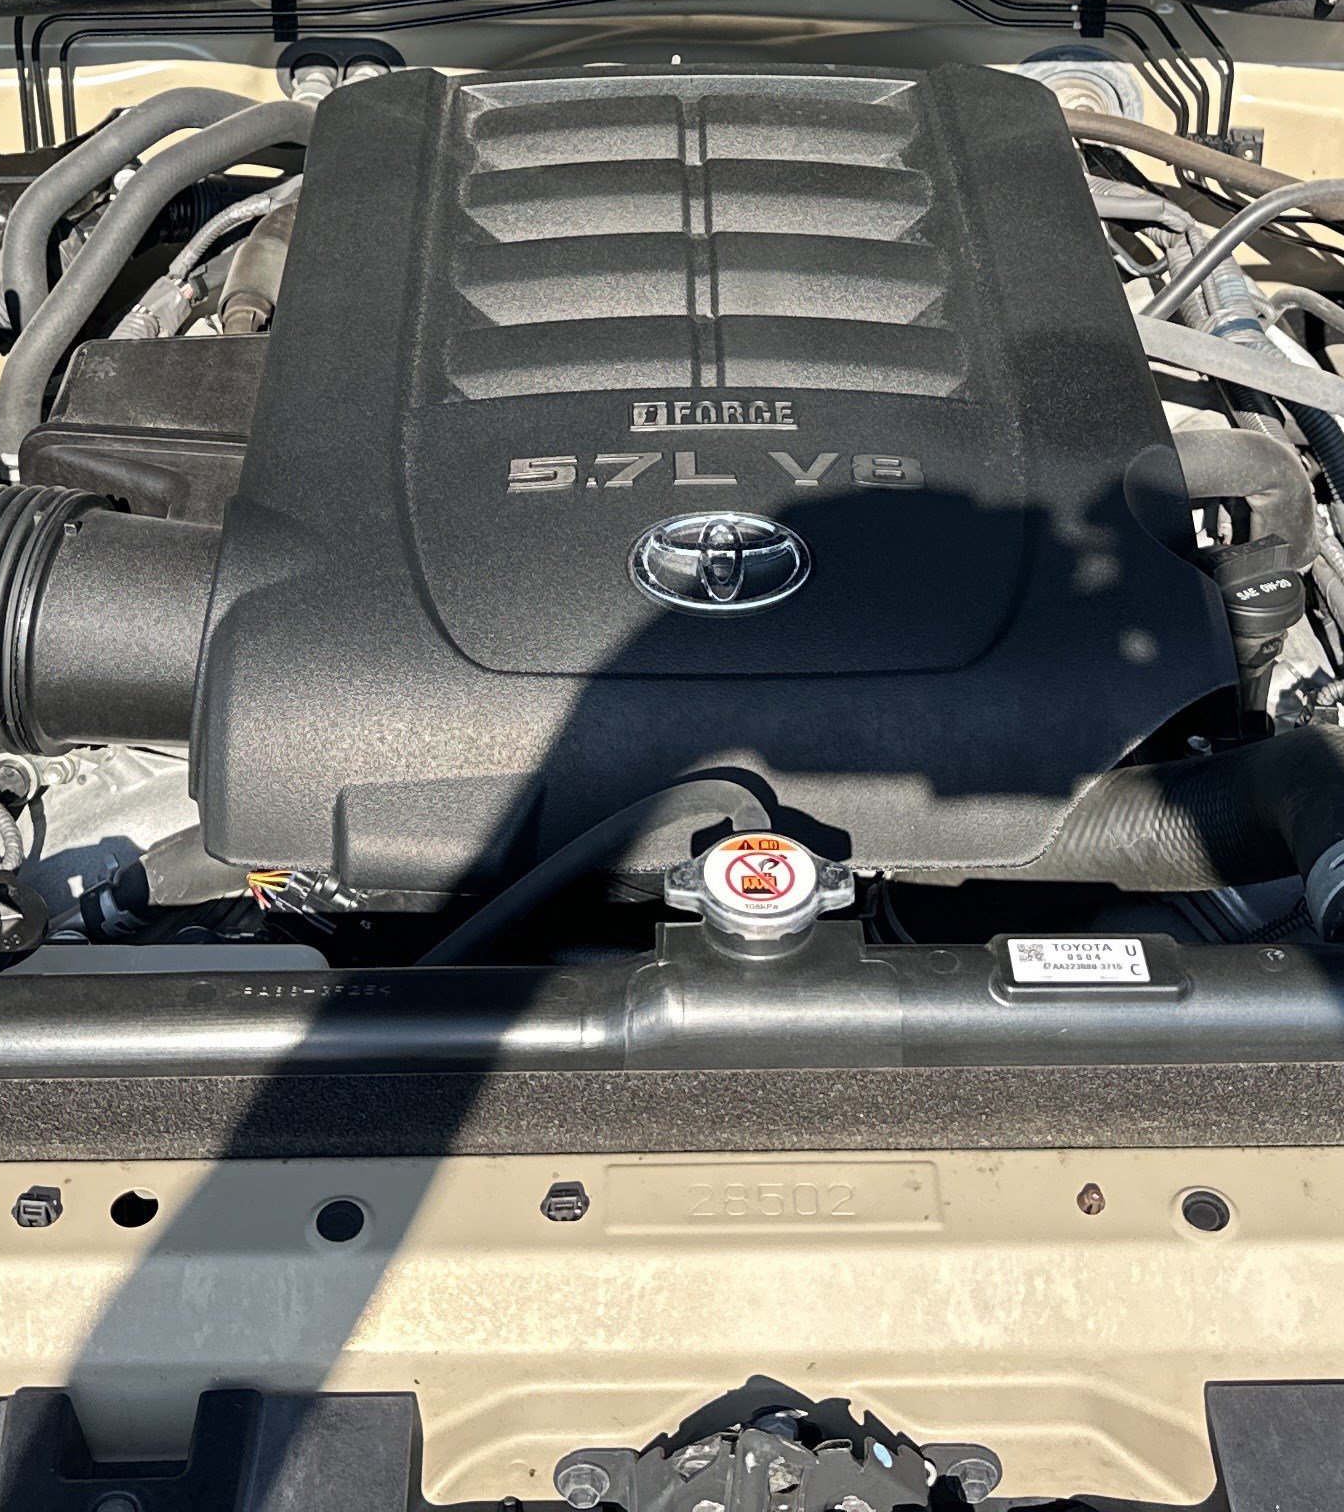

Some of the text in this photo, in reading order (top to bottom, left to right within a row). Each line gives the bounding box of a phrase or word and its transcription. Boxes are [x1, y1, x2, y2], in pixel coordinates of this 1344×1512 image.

[507, 450, 926, 494] 5.7L V8
[1235, 587, 1260, 601] SAE
[1051, 943, 1113, 952] TOYOTA
[1124, 944, 1137, 957] U
[1130, 963, 1143, 976] C
[690, 1182, 857, 1216] 28502
